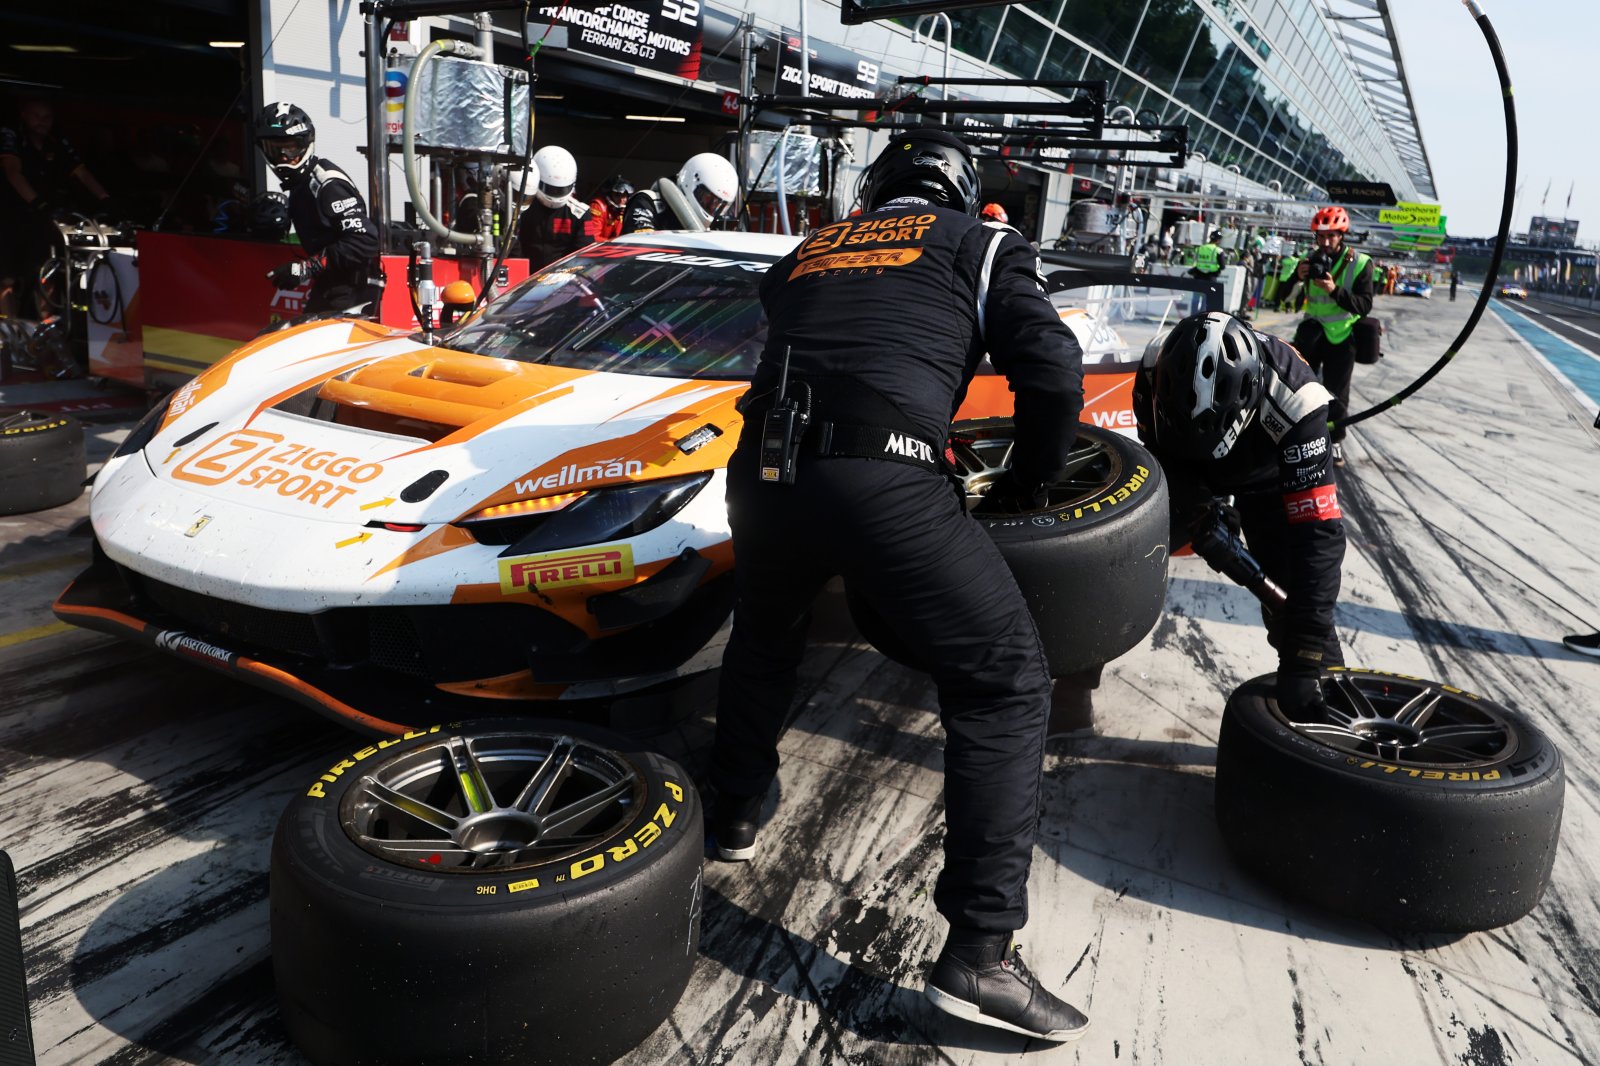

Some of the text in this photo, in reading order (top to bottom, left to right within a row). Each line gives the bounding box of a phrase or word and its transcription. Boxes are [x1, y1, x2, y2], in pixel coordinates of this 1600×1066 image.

[612, 4, 650, 28] CORSE
[661, 0, 700, 27] 52
[581, 29, 656, 60] FERRARI 296 GT3
[648, 31, 691, 56] MOTORS
[809, 73, 841, 94] SPORT
[856, 60, 879, 85] 93
[723, 95, 739, 110] 46
[853, 214, 937, 232] ZIGGO
[845, 226, 931, 245] SPORT
[802, 252, 904, 273] TEMPESTA
[806, 267, 884, 280] racing
[1263, 412, 1286, 438] OMP
[1301, 437, 1326, 451] ZIGGO
[1302, 444, 1327, 459] SPORT
[268, 443, 384, 484] ZIGGO
[237, 465, 358, 509] SPORT
[1074, 465, 1150, 519] PIRELLI
[1287, 496, 1329, 514] SRO
[511, 551, 622, 587] PIRELLI
[306, 724, 442, 799] PIRELLI
[1360, 761, 1501, 781] PIRELLI
[664, 781, 683, 802] P
[570, 802, 678, 880] ZERO
[476, 885, 497, 895] DHG
